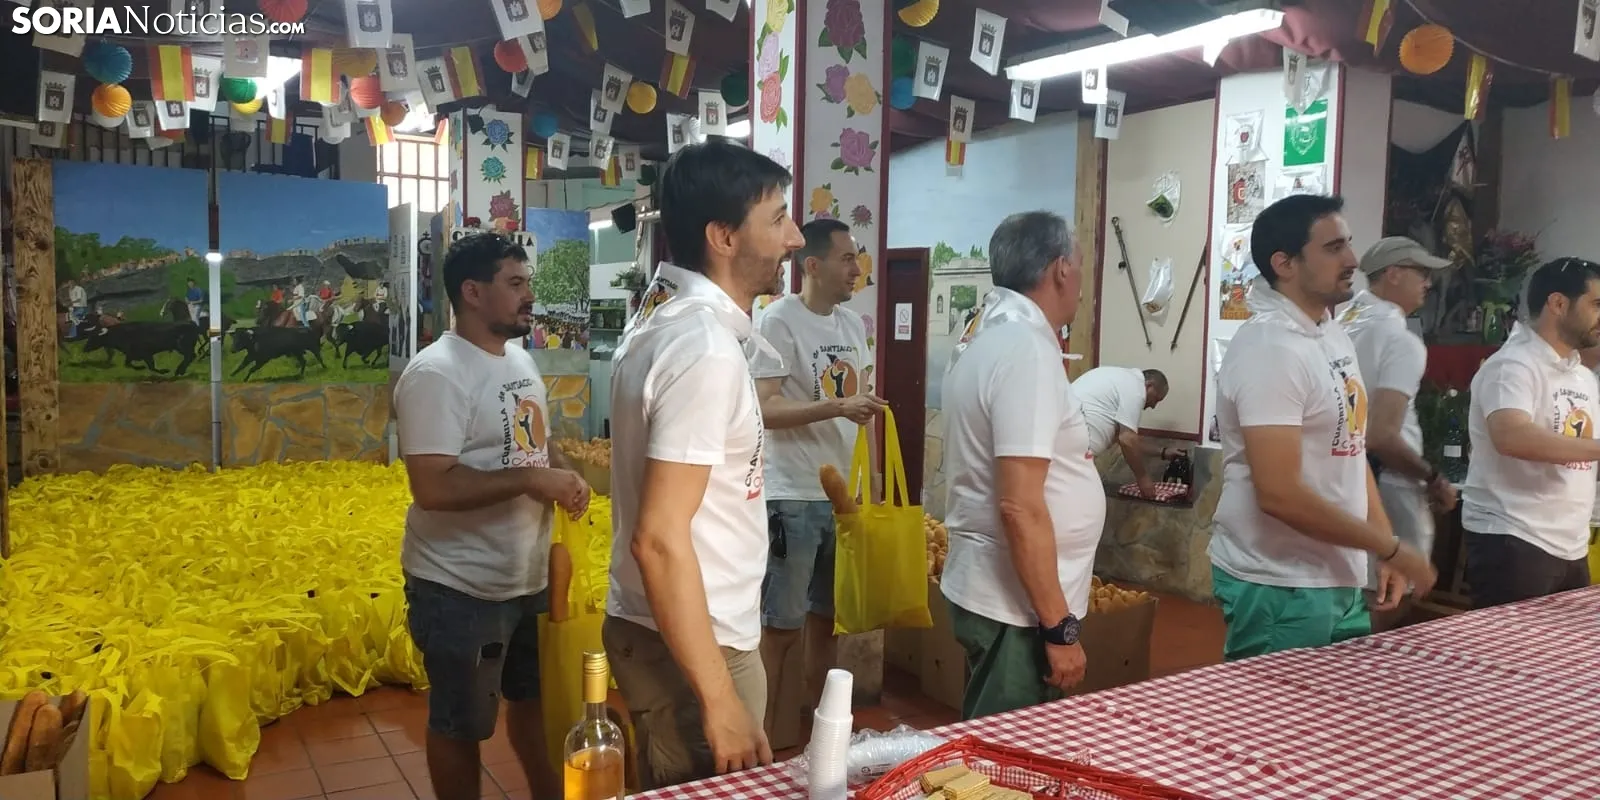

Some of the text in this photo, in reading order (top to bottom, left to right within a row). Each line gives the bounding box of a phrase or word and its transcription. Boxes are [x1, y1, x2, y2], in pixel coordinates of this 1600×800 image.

[811, 362, 820, 402] UADRILLA
[819, 345, 853, 353] SANTIAGO
[501, 407, 513, 466] CUADRILLA
[1331, 386, 1344, 447] CUADRILLA
